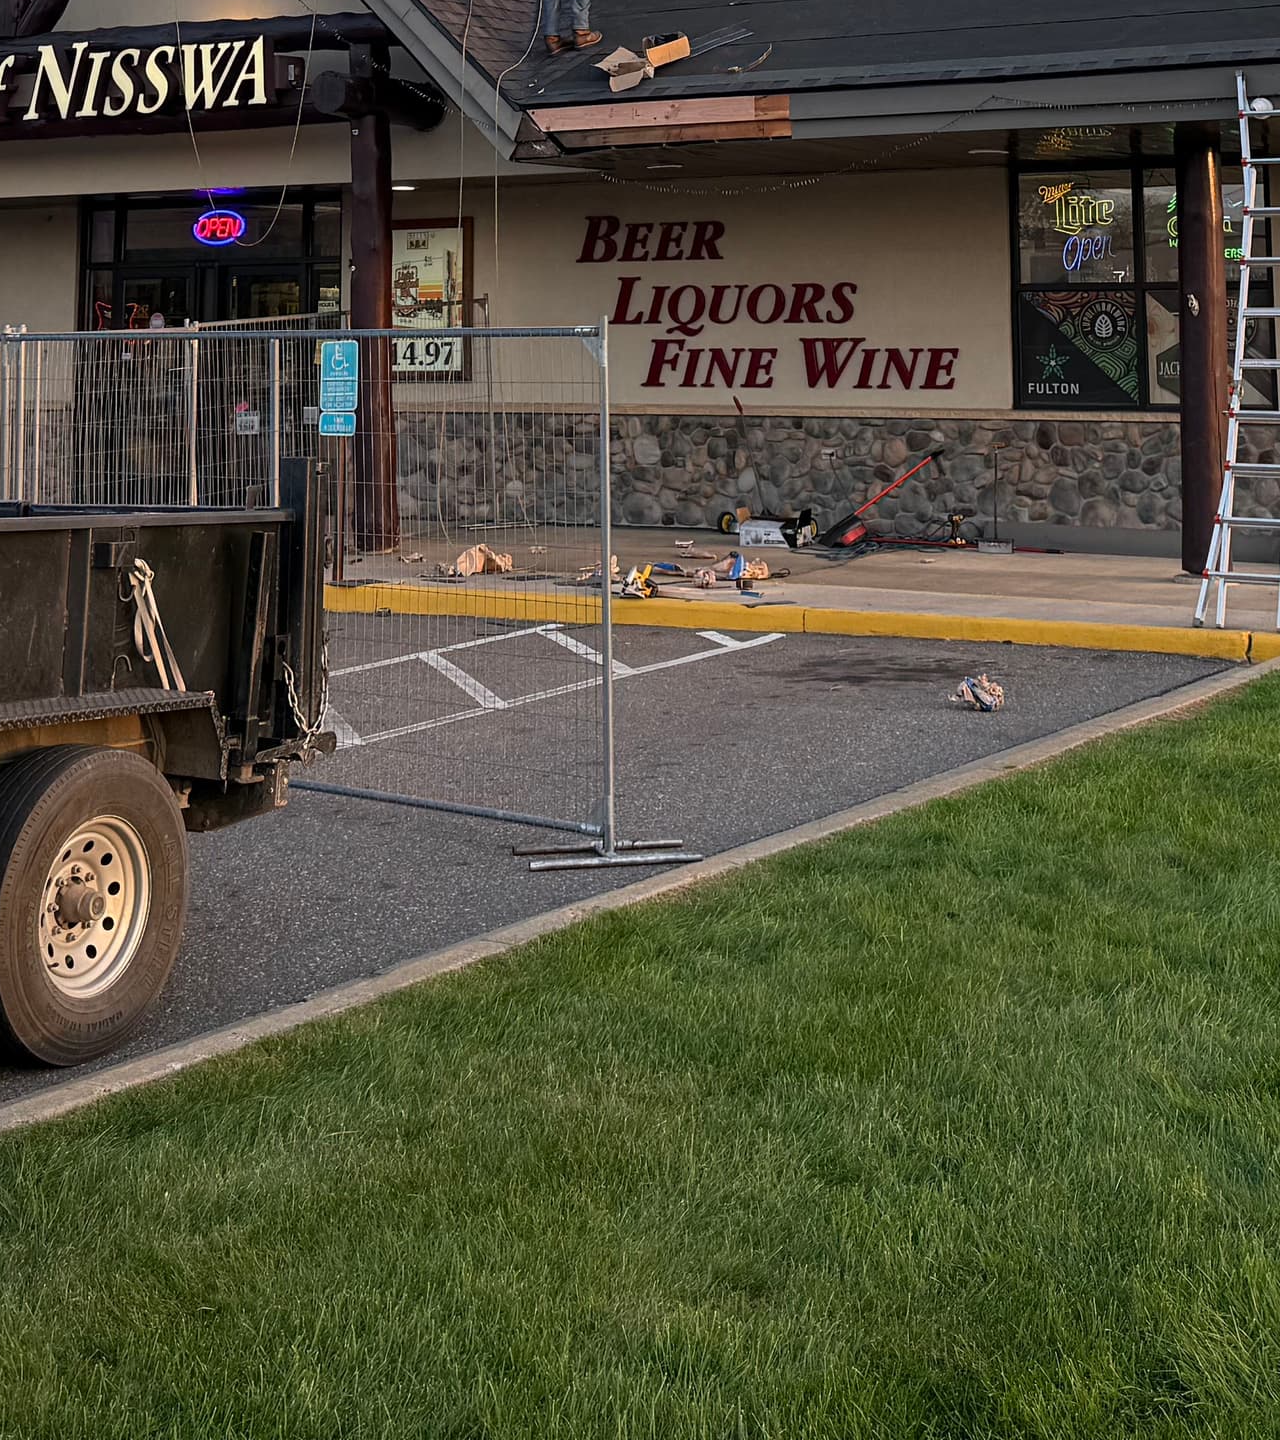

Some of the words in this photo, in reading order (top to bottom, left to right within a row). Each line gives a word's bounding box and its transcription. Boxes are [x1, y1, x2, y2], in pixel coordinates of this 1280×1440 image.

[22, 35, 268, 120] NISSWA
[196, 217, 241, 238] OPEN
[1053, 195, 1115, 235] Lite
[576, 215, 725, 263] BEER
[1062, 235, 1117, 271] Open
[608, 276, 857, 337] LIQUORS
[640, 339, 778, 389] FINE
[799, 337, 960, 390] WINE
[1027, 382, 1080, 395] FULTON
